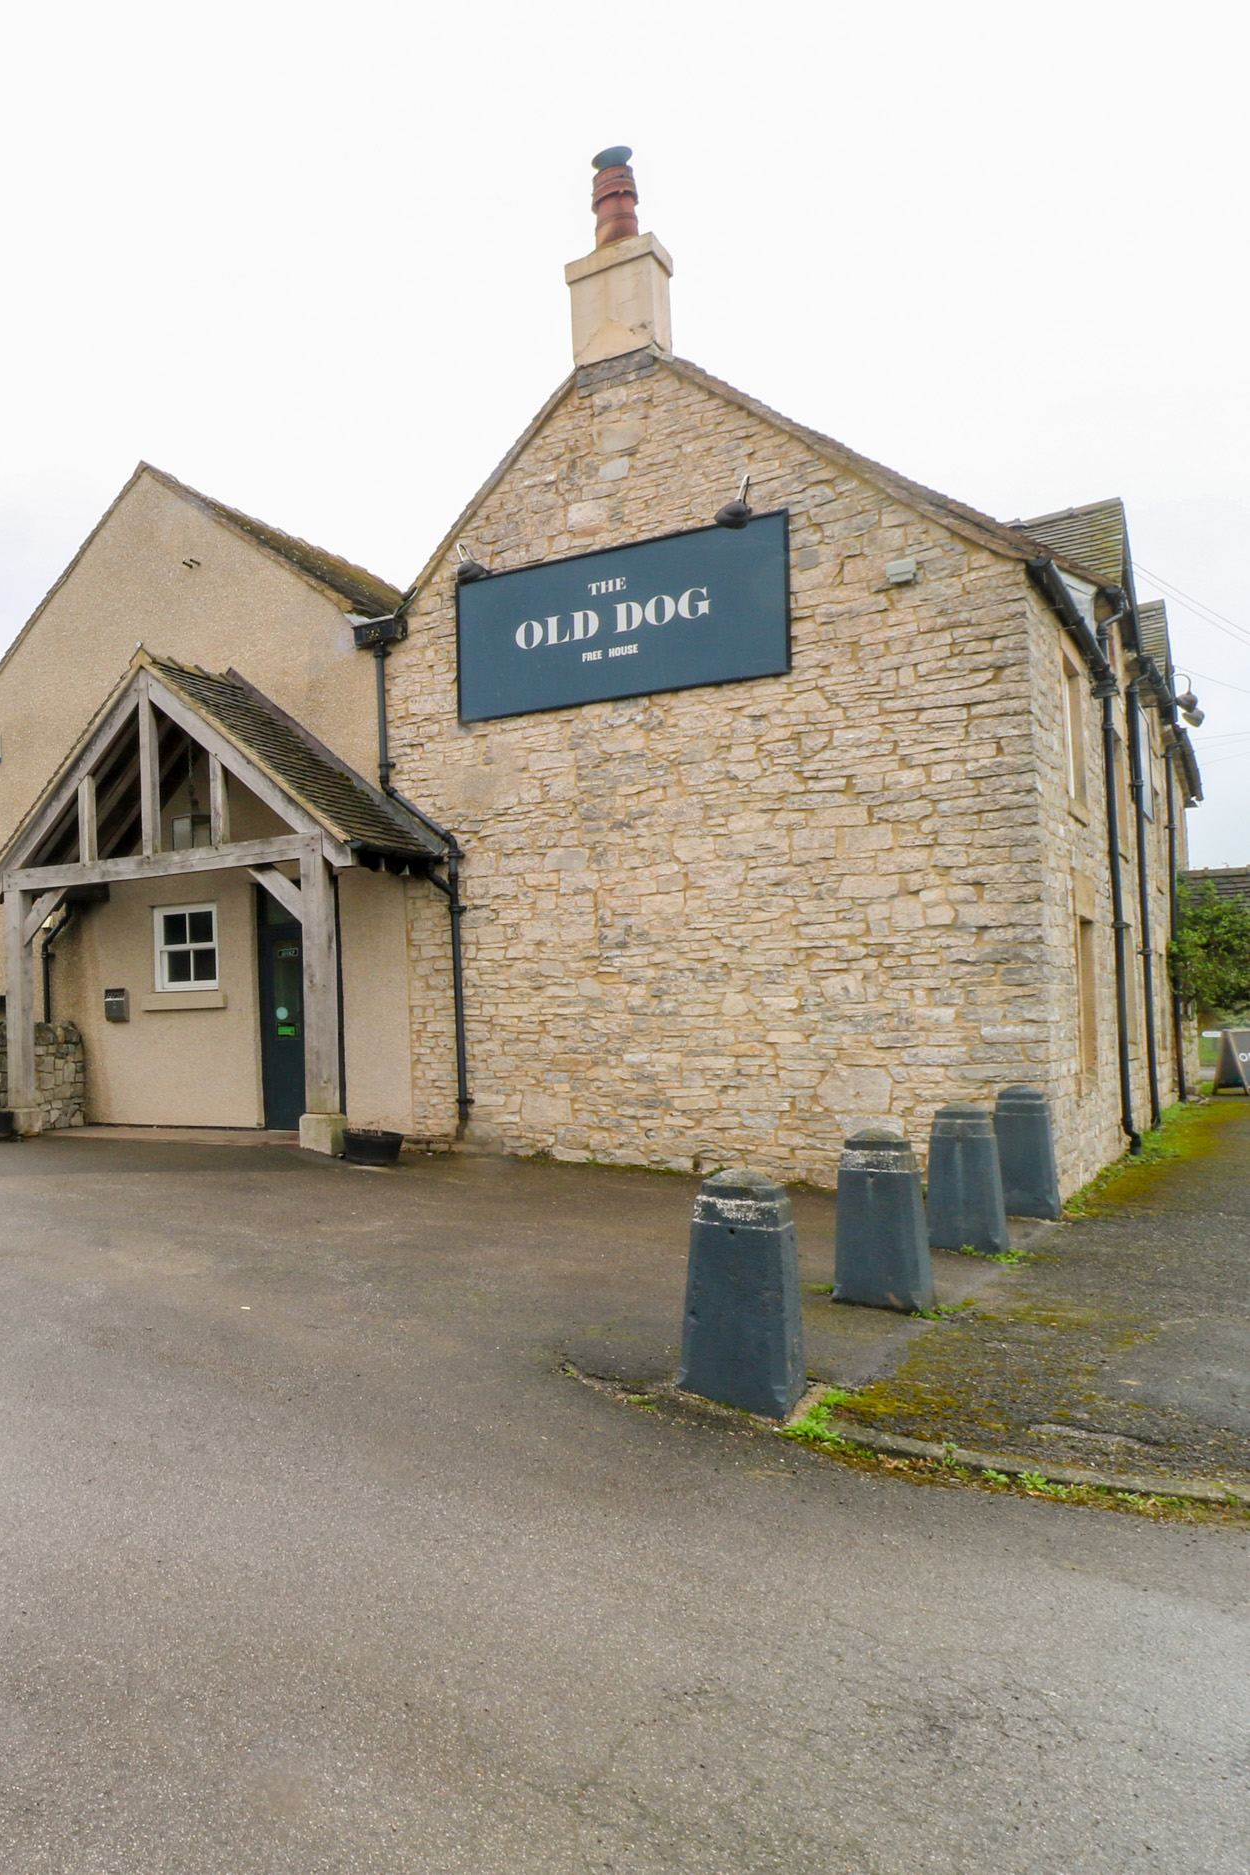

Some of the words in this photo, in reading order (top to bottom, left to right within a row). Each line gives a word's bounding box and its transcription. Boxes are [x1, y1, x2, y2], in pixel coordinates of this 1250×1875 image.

[588, 577, 626, 595] THE
[515, 610, 599, 649] OLD
[613, 587, 711, 633] DOG
[582, 650, 603, 662] FREE
[608, 644, 639, 657] HOUSE
